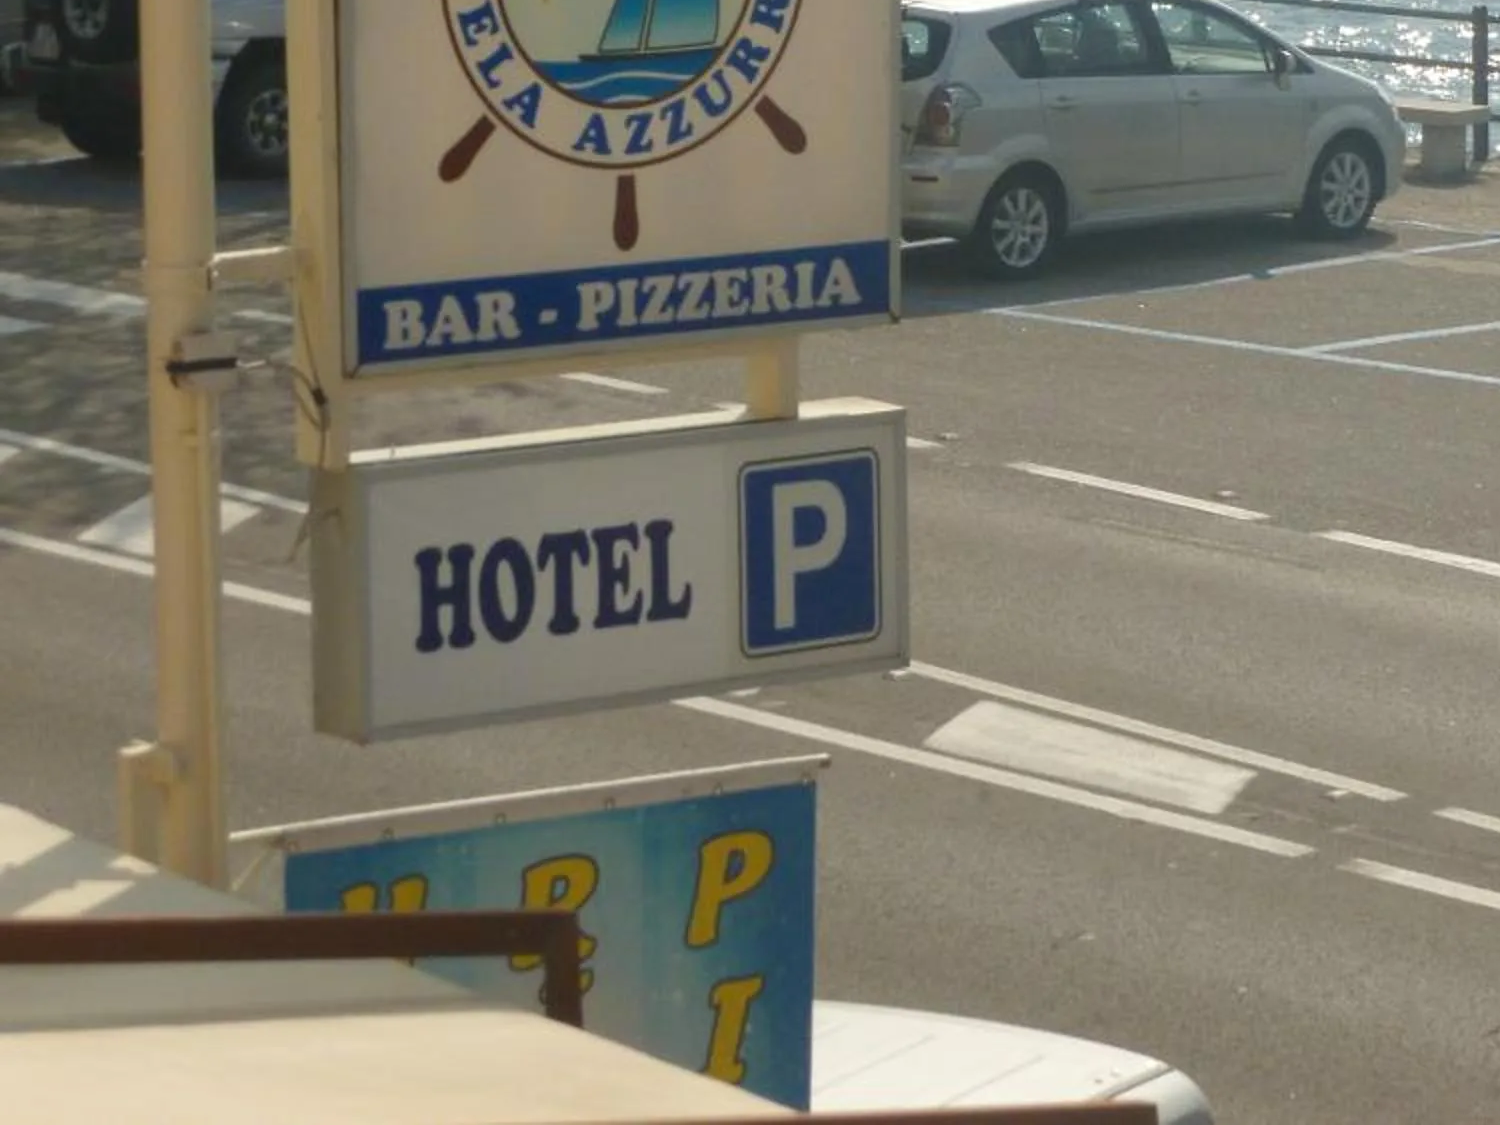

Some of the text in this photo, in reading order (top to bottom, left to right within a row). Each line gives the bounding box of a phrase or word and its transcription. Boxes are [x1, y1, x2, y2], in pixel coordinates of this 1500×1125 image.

[383, 292, 520, 350] BAR
[577, 258, 861, 331] PIZZERIA
[414, 520, 691, 653] HOTEL
[773, 479, 847, 630] P
